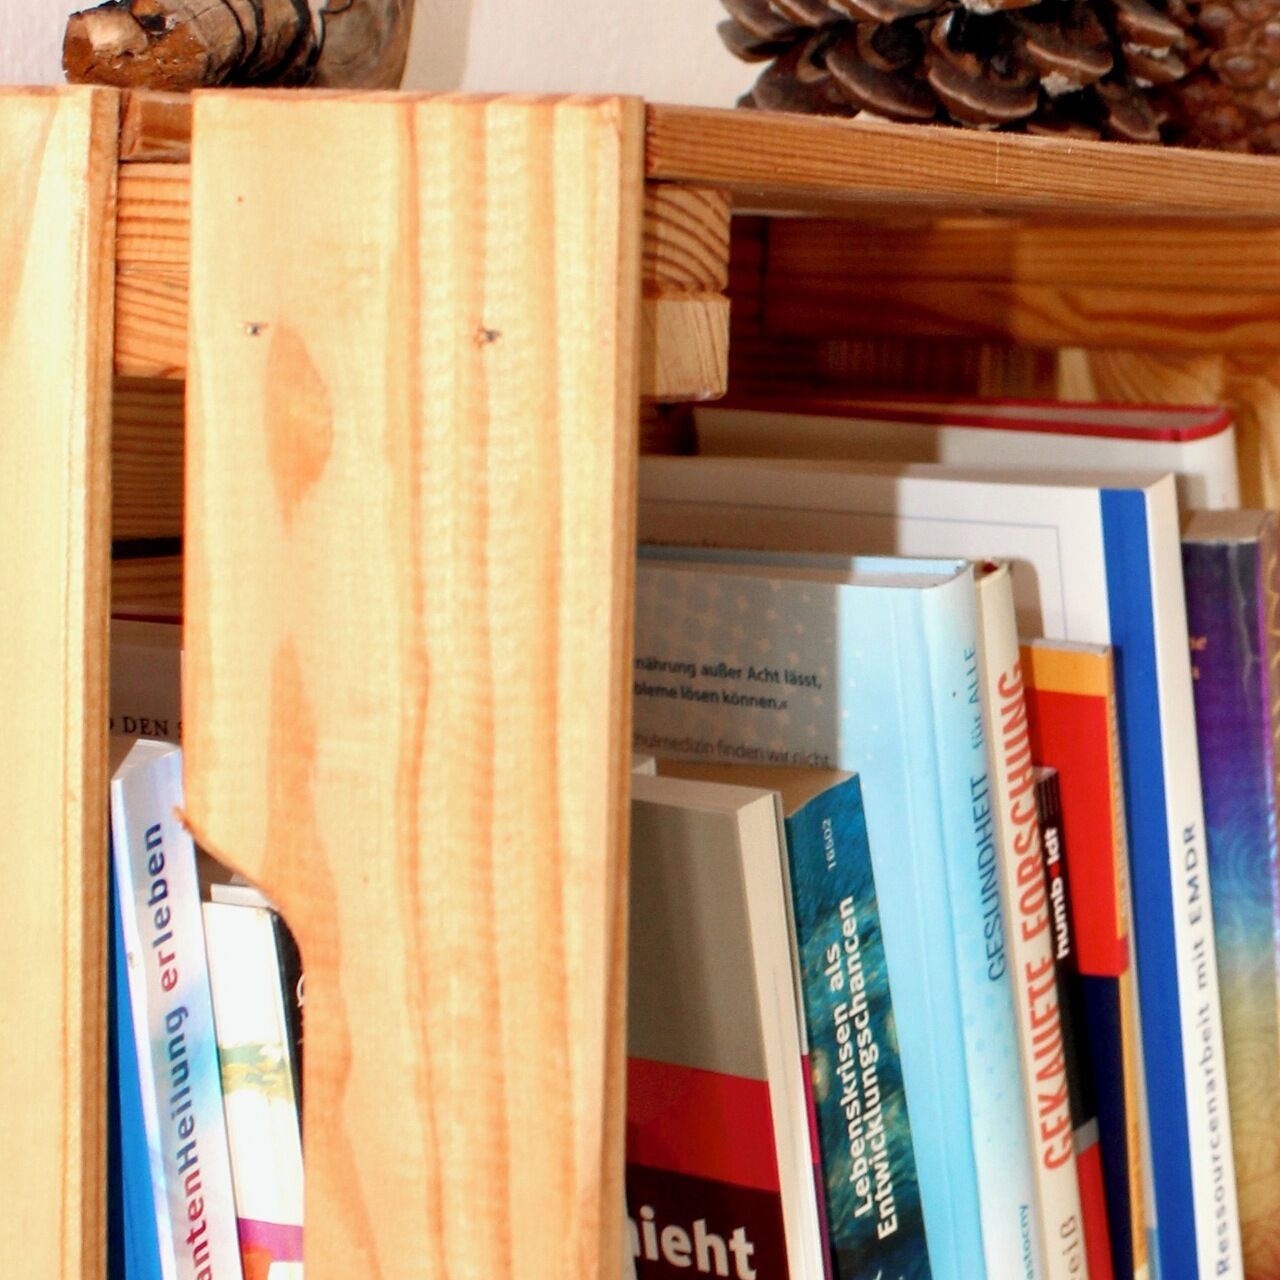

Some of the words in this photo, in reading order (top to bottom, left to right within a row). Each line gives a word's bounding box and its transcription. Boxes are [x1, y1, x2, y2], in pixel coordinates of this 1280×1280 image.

[123, 716, 168, 736] DEN
[681, 686, 719, 703] lösen
[701, 663, 742, 680] außer
[747, 666, 780, 684] Acht
[963, 647, 980, 705] ALLE
[997, 659, 1050, 943] FORSCHUNG
[144, 822, 179, 993] erleben
[970, 773, 1006, 982] GESUNDHEIT
[1182, 823, 1203, 925] EMDR
[824, 942, 845, 993] als
[1192, 937, 1208, 990] mit
[833, 1002, 874, 1219] Lebenskrisen
[839, 895, 899, 1241] Entwicklungschancen
[1025, 955, 1073, 1170] GEKAUFTE
[1196, 1002, 1233, 1277] Ressourcenarbeit
